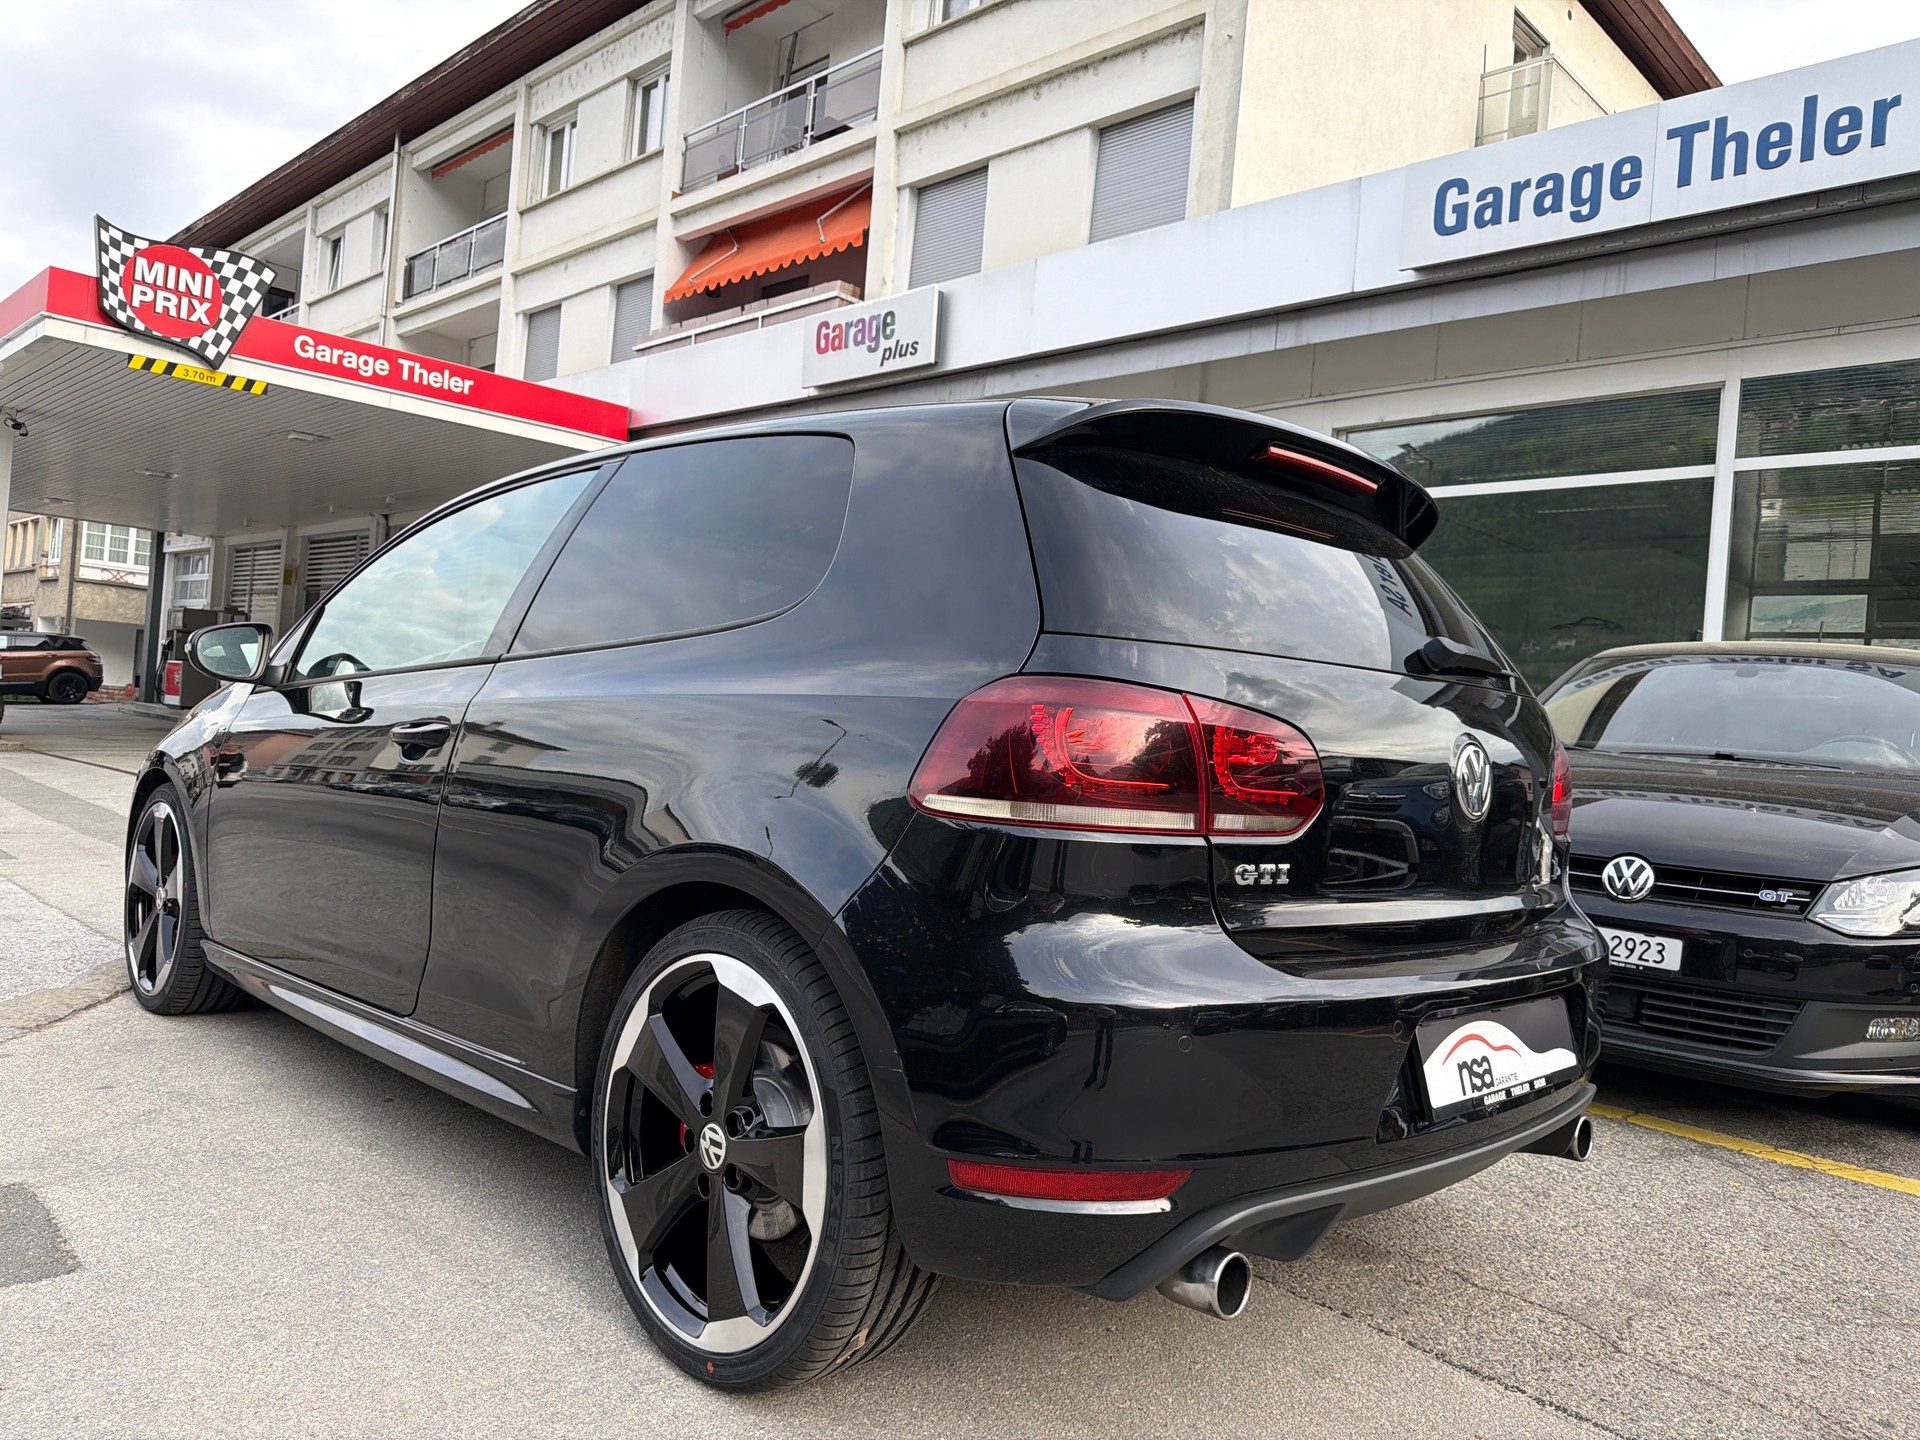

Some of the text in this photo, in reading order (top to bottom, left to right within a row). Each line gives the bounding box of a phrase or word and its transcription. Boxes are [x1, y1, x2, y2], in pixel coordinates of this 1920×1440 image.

[1433, 94, 1902, 237] Garage Theler
[134, 256, 214, 299] MINI
[131, 284, 212, 326] PRIX
[816, 310, 896, 355] Garage
[293, 334, 475, 395] Garage Theler
[879, 339, 920, 367] plus
[183, 368, 205, 381] 3.70
[1234, 863, 1291, 887] GTI
[1758, 889, 1794, 903] GT
[1610, 935, 1666, 964] 2923
[1457, 1055, 1495, 1096] nsa
[1483, 1090, 1507, 1106] GARAGE
[1510, 1082, 1531, 1097] THELER
